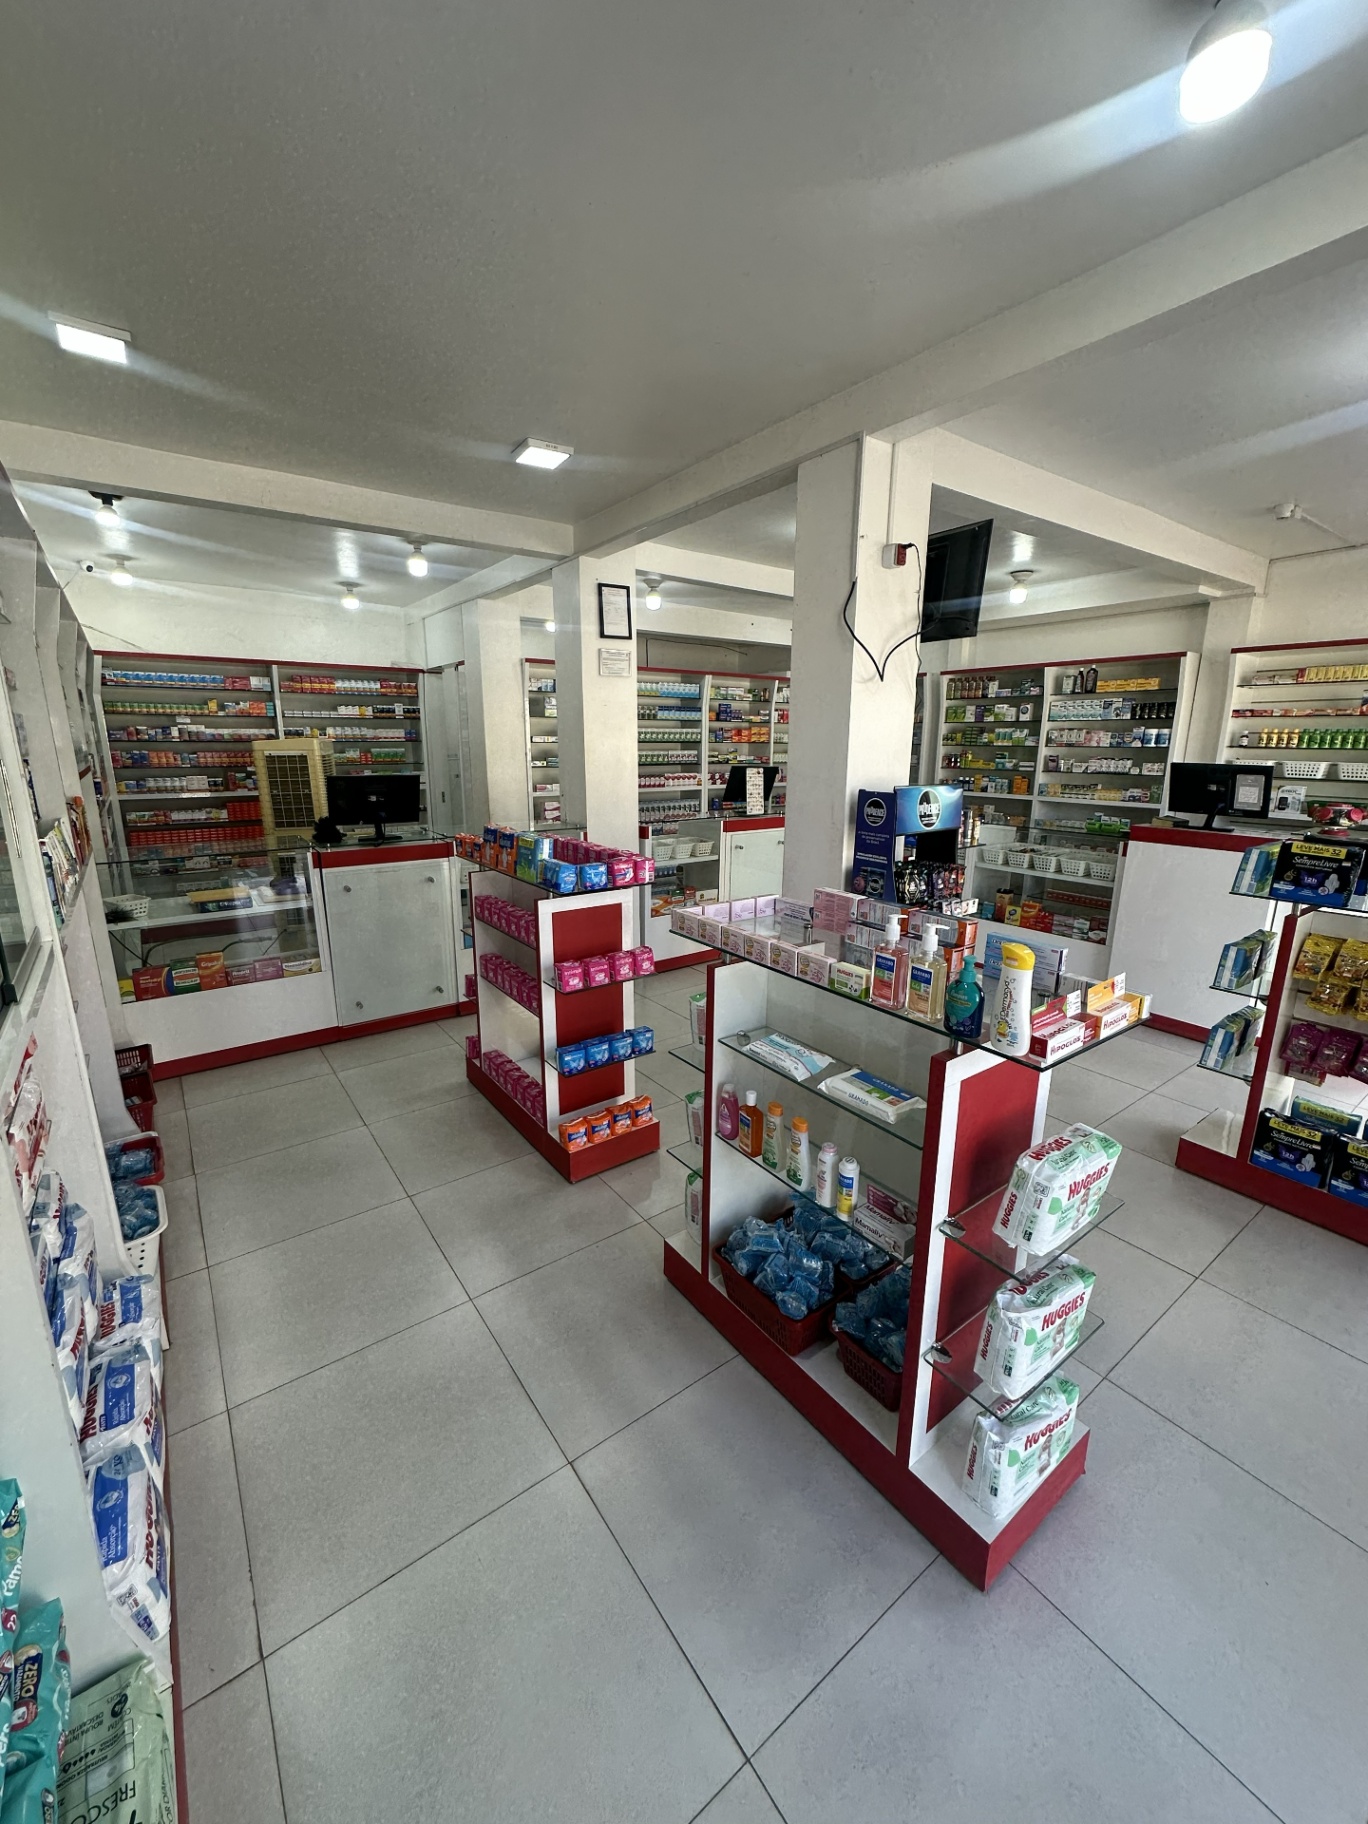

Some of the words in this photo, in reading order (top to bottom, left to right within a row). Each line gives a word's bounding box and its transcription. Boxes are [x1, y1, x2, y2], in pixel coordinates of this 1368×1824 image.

[1067, 1162, 1111, 1201] HUGGIES
[1000, 1191, 1018, 1230] HUGGIES
[1041, 1292, 1086, 1332] HUGGIES
[980, 1321, 993, 1361] HUGGIES
[80, 1383, 99, 1443] HUGGIES
[21, 1663, 39, 1698] ZERO
